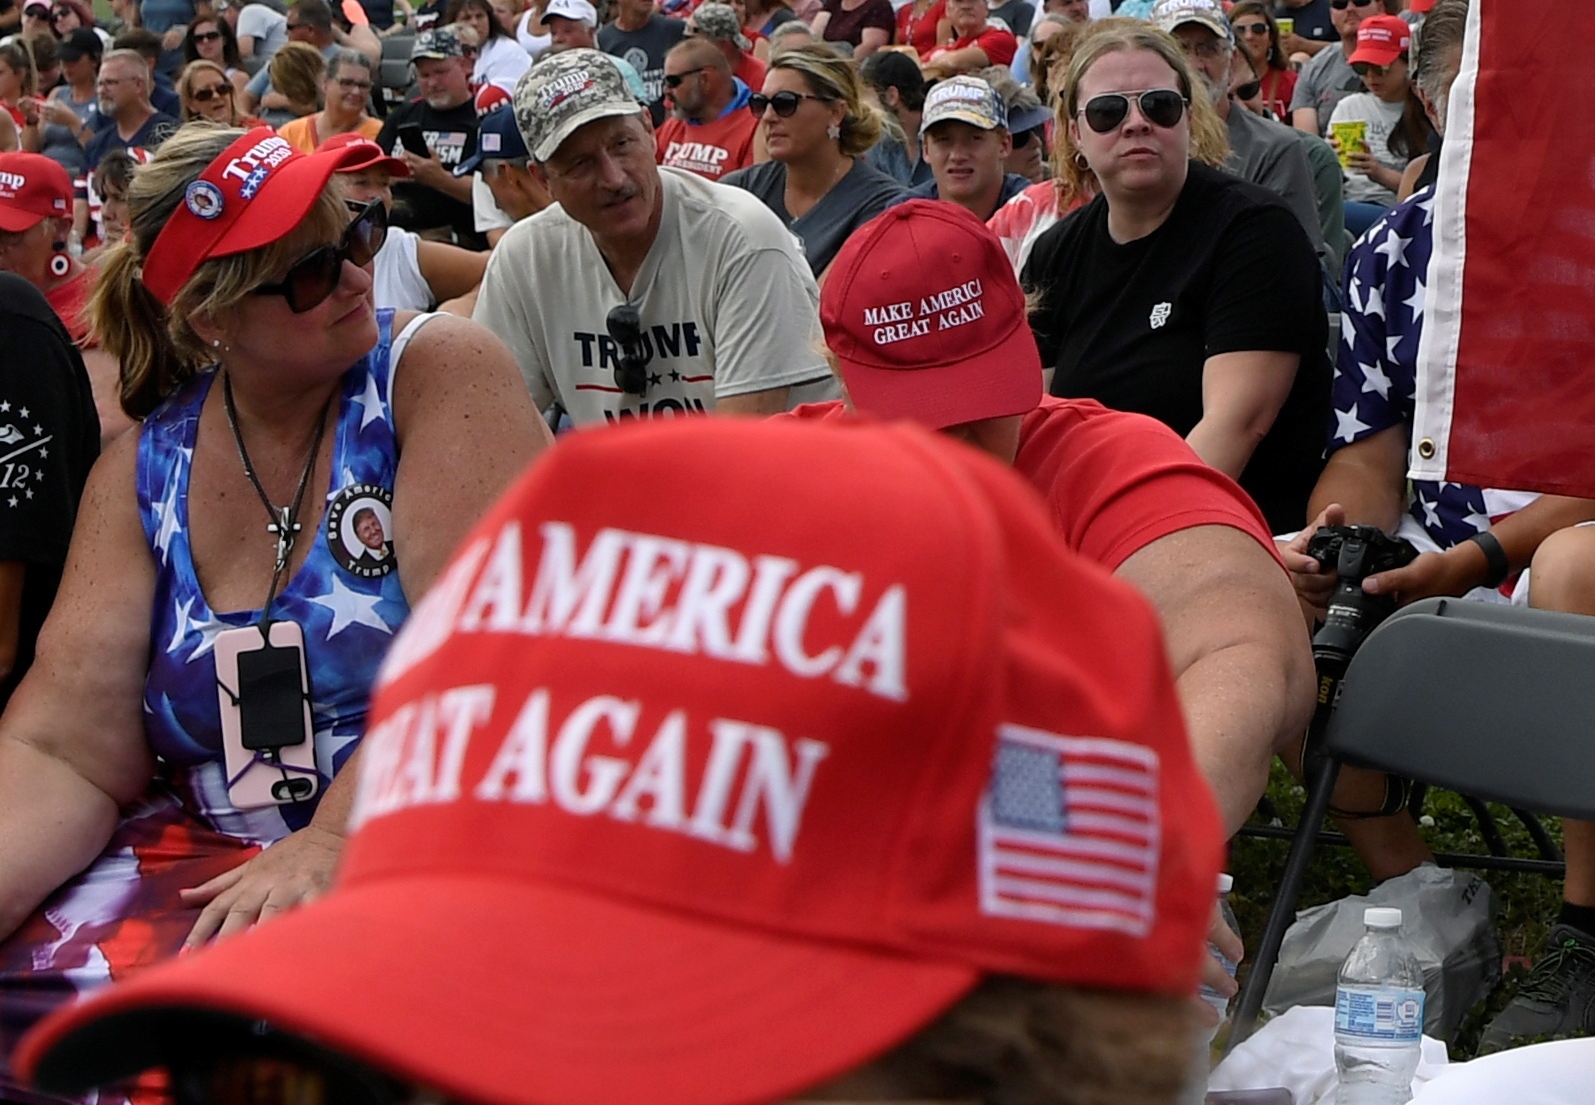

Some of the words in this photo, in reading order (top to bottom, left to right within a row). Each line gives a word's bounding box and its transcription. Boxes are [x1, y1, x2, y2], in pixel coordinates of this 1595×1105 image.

[537, 71, 589, 99] Trump
[930, 85, 984, 101] TRUMP
[222, 136, 291, 182] Trump
[863, 302, 913, 325] MAKE
[919, 278, 983, 316] AMERICA
[874, 318, 930, 345] GREAT
[938, 300, 985, 331] AGAIN
[345, 485, 391, 502] Americ
[348, 560, 389, 577] Trump
[457, 520, 909, 703] AMERICA
[1318, 675, 1333, 704] kon
[475, 687, 831, 865] AGAIN
